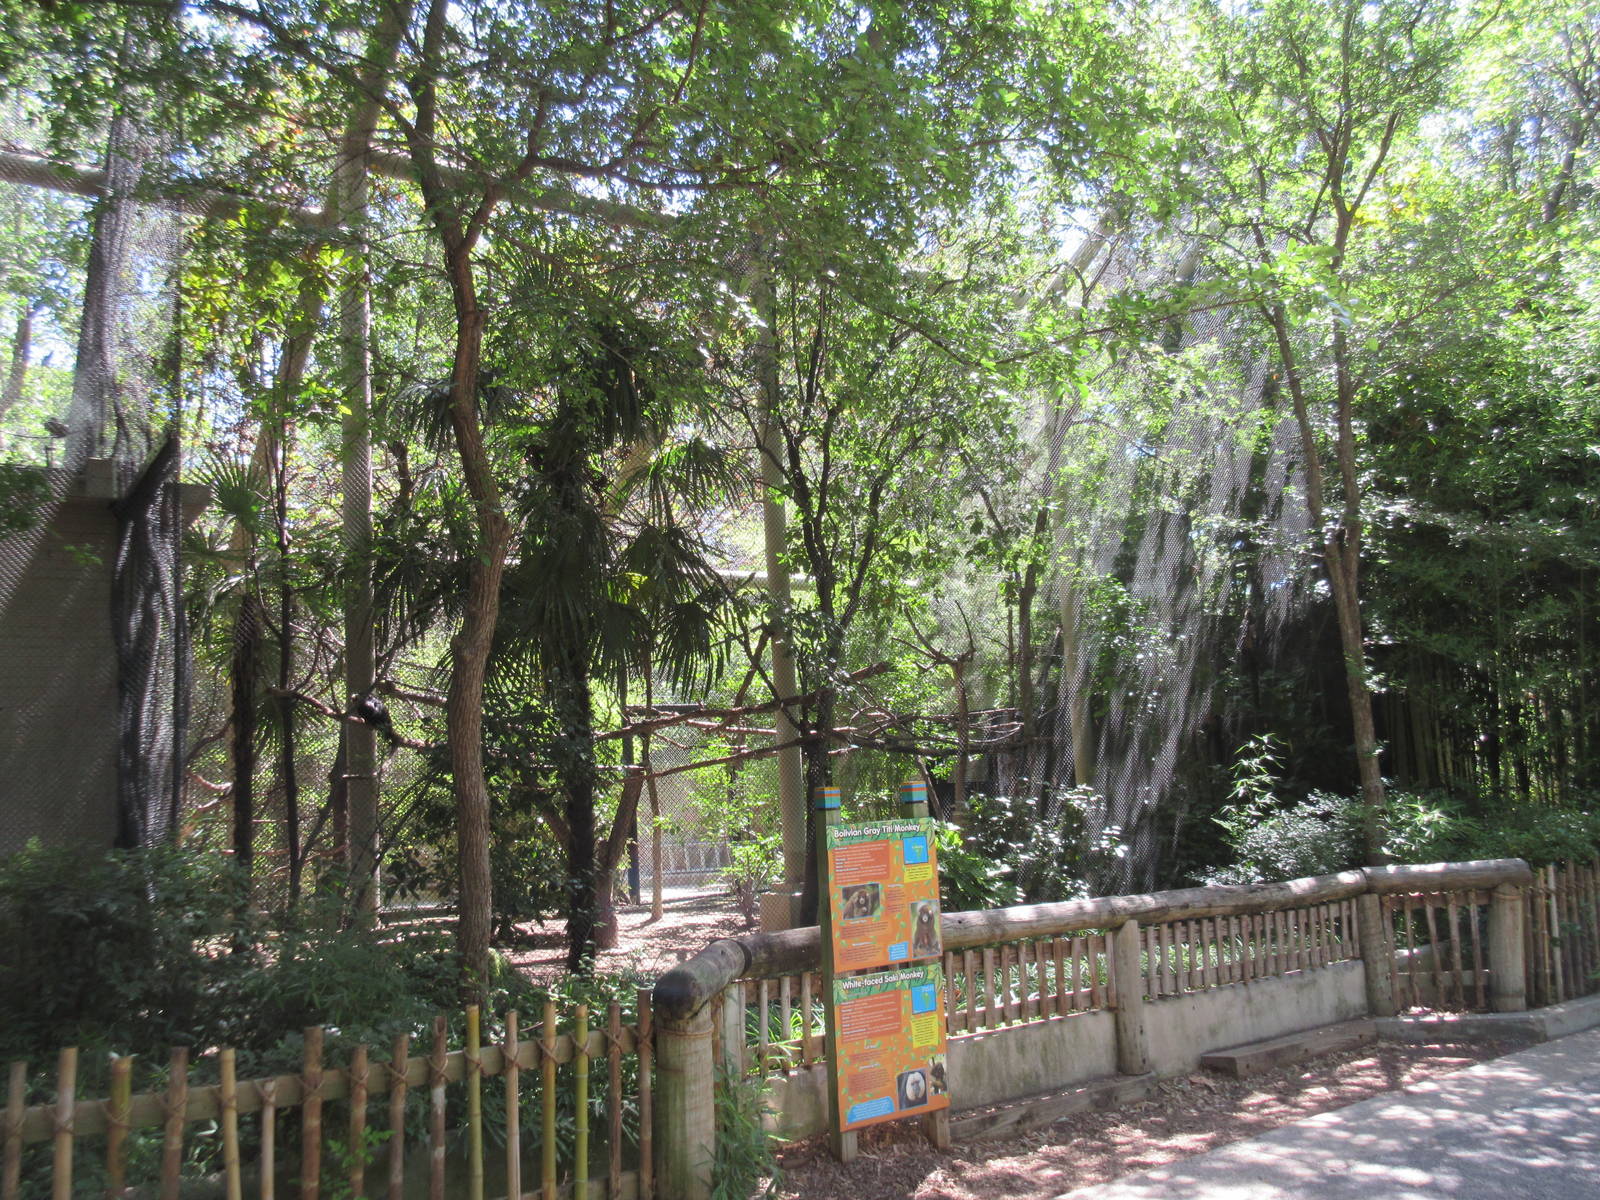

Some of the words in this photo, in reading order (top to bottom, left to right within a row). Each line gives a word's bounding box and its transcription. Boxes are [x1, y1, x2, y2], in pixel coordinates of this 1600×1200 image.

[833, 828, 862, 838] Bolivian
[863, 827, 881, 836] Gray
[893, 823, 921, 832] Monkey
[842, 976, 884, 989] White-faced
[884, 974, 899, 983] Saki
[899, 970, 924, 980] Monkey
